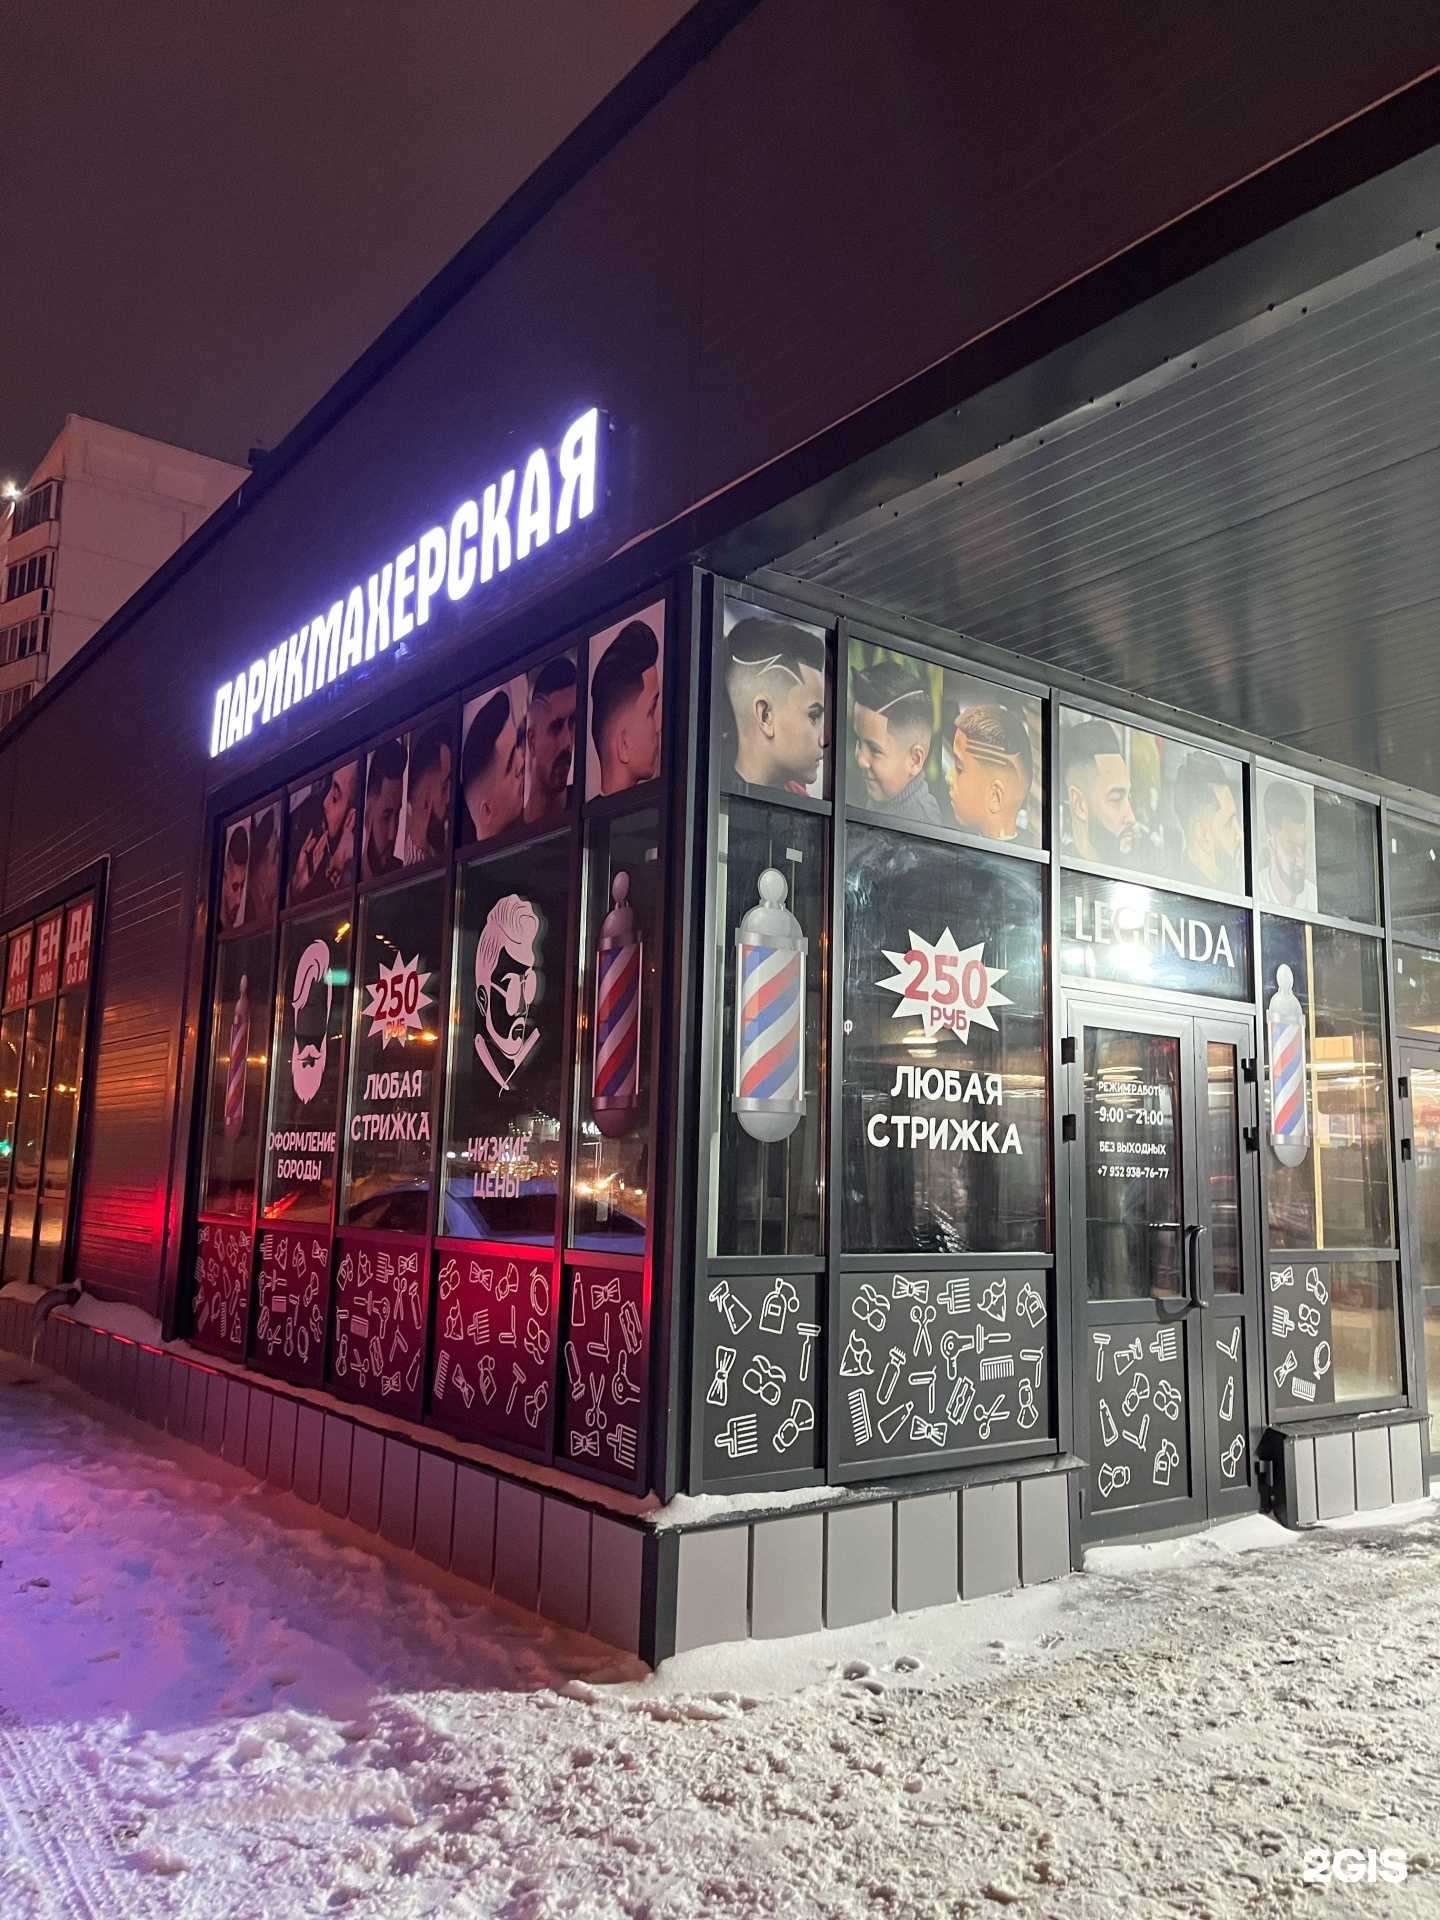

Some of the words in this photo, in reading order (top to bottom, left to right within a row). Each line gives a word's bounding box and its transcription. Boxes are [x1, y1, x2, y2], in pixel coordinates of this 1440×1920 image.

[209, 407, 598, 758] ПАРИКМАХЕРСКАЯ
[1075, 896, 1236, 968] LEGENDA
[903, 950, 989, 1008] 250
[374, 971, 419, 1021] 250
[930, 1006, 968, 1031] РУБ
[363, 1069, 422, 1100] ЛЮБАЯ
[890, 1065, 1003, 1106] ЛЮБАЯ
[350, 1111, 430, 1141] СТРИЖКА
[1098, 1106, 1124, 1123] 9:00
[1135, 1110, 1164, 1126] 21:00
[467, 1136, 531, 1162] НИЗКИЕ
[867, 1113, 1023, 1155] СТРИЖКА
[1099, 1141, 1115, 1152] БЕЗ
[1116, 1142, 1167, 1155] ВЫХОДНЫХ
[277, 1158, 322, 1182] БОРОДЫ
[1097, 1166, 1107, 1177] +7
[473, 1172, 520, 1199] ЦЕНЫ
